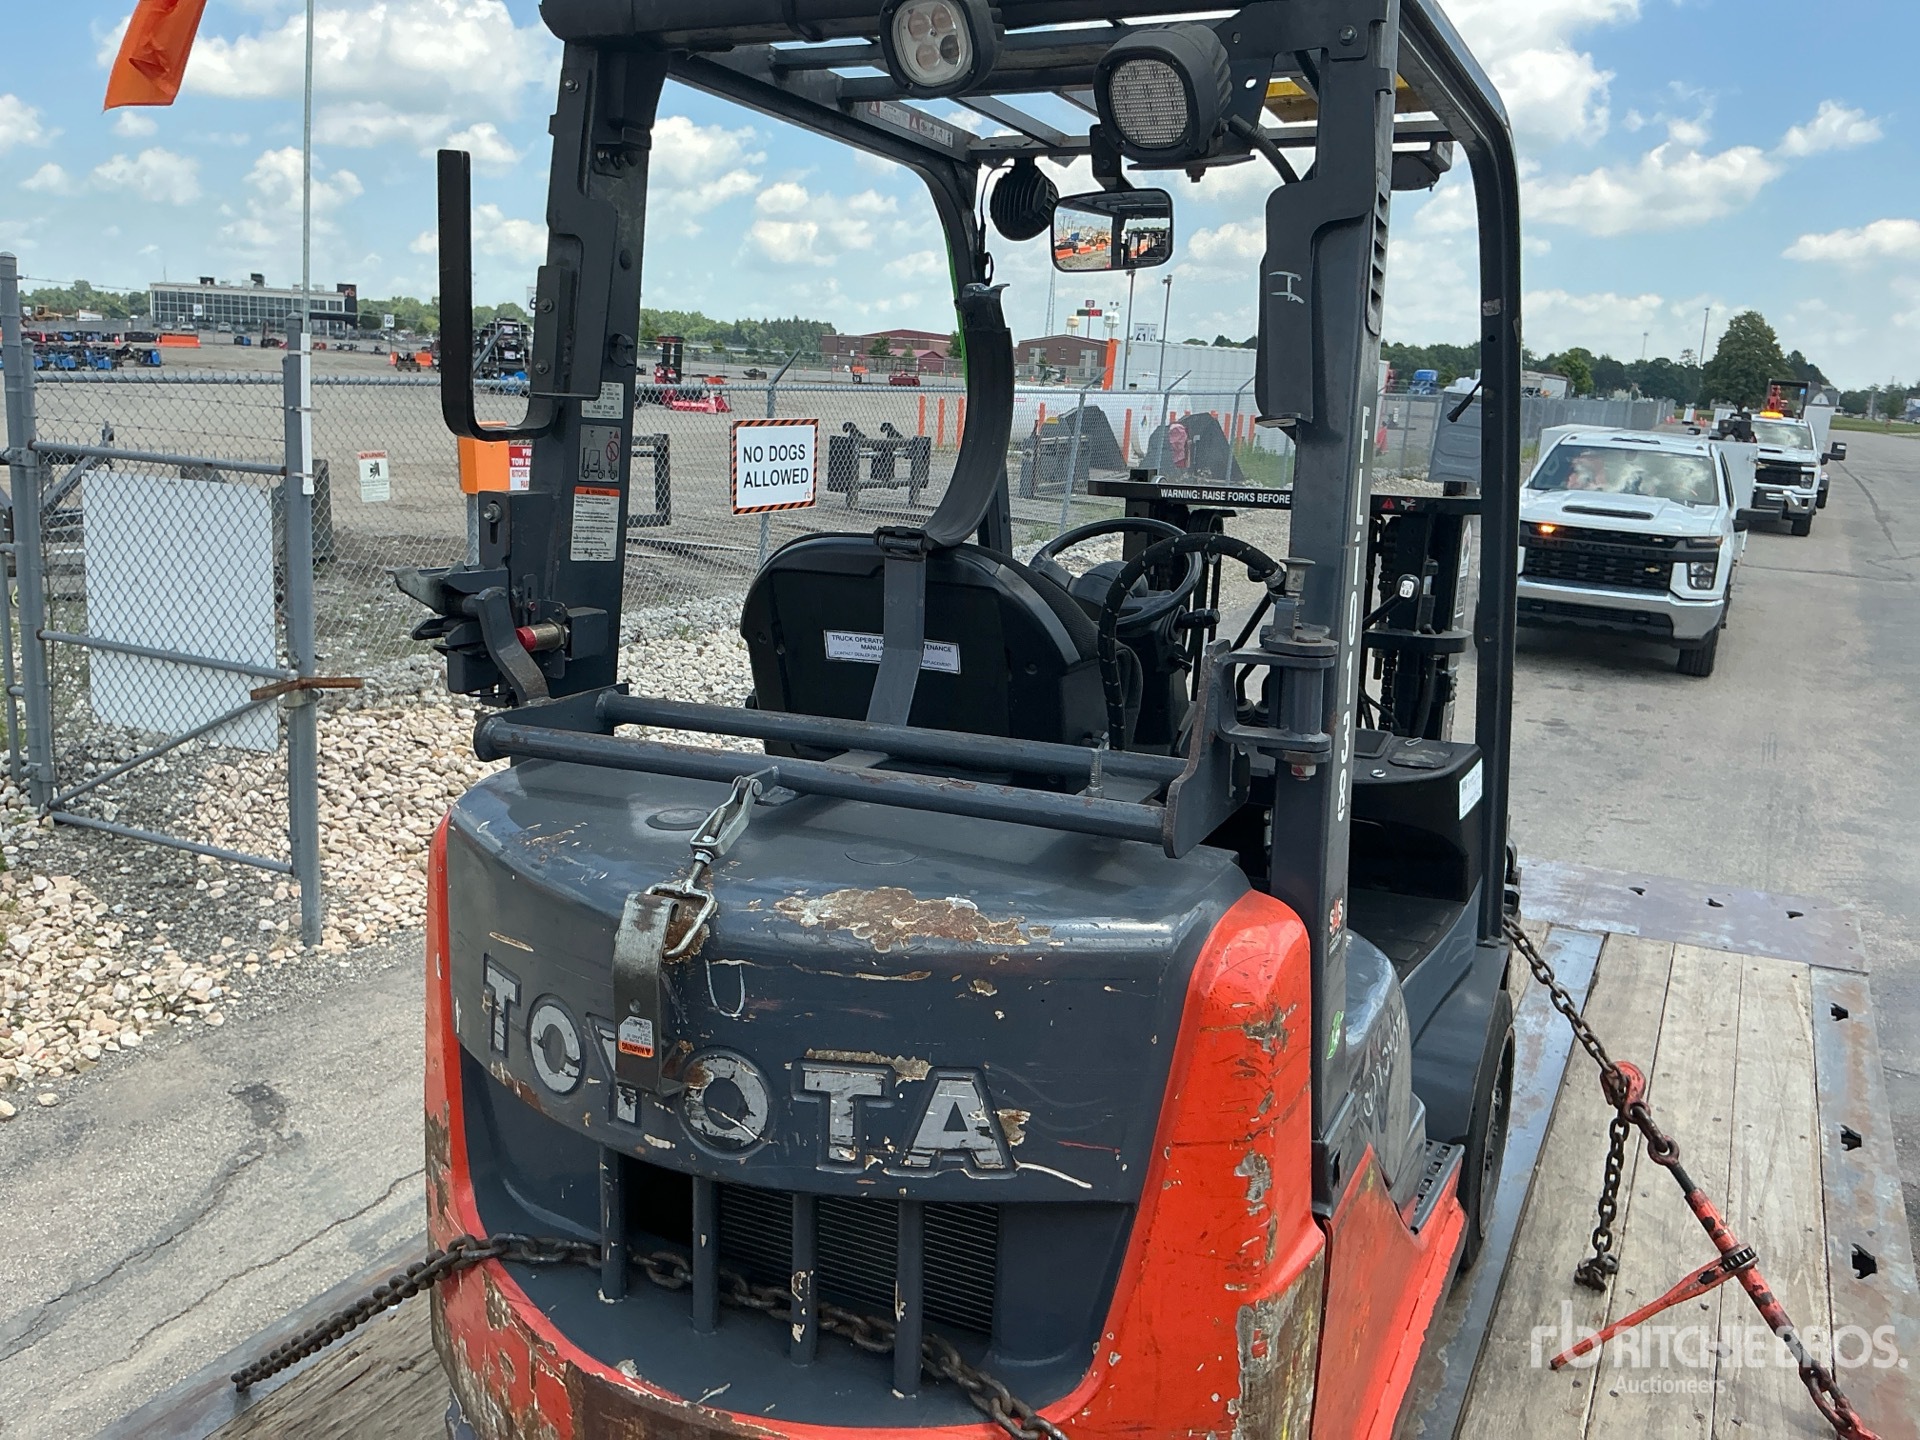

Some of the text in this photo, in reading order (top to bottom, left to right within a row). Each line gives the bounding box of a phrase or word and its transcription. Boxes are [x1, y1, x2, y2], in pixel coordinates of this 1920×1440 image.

[511, 458, 524, 466] TOW
[743, 444, 806, 463] NO DOGS
[743, 467, 809, 488] ALLOWED
[1160, 488, 1291, 504] WARNING: RAISE FORKS BEFORE
